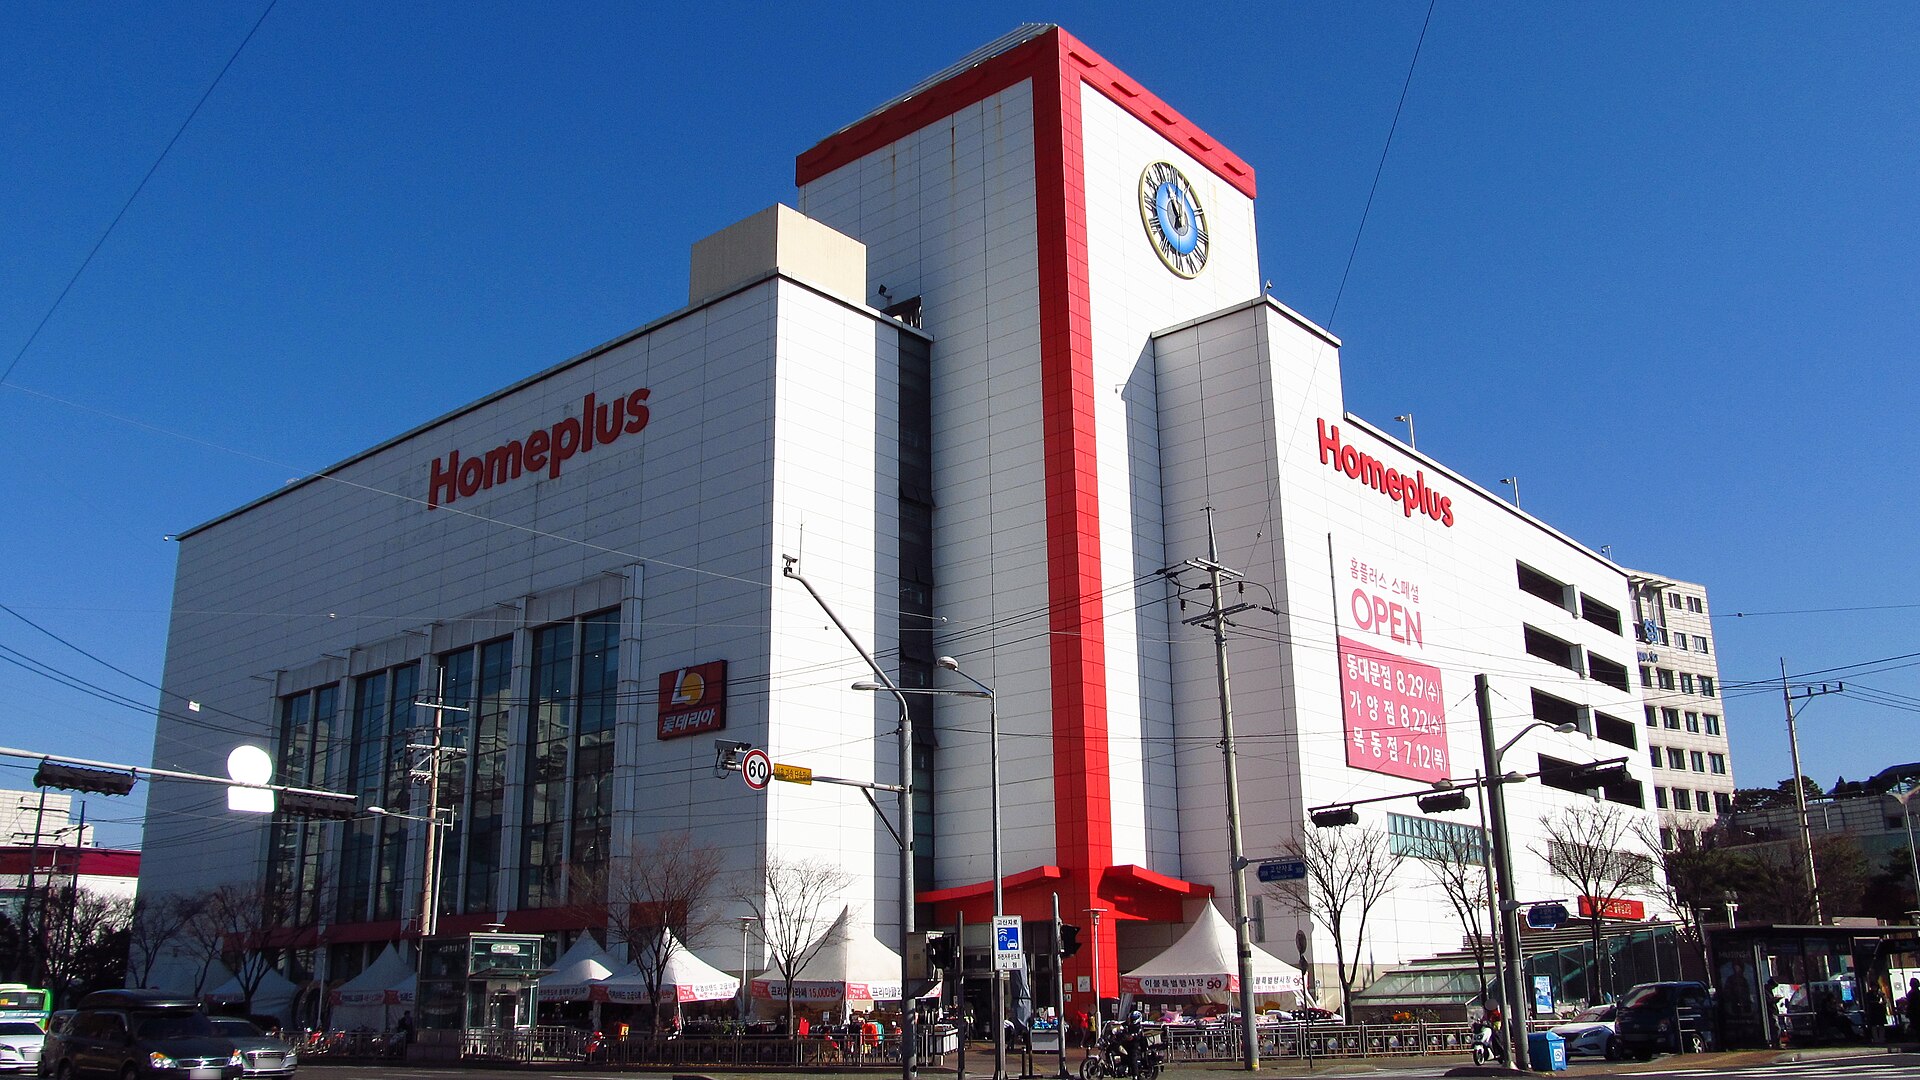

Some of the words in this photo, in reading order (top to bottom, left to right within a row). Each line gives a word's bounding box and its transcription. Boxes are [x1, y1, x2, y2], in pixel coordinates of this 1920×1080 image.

[428, 388, 651, 511] Homeplus
[1317, 417, 1454, 527] Homeplus
[1350, 557, 1387, 589] 홈플러스
[1392, 578, 1419, 604] 스페셜
[1351, 588, 1423, 650] OPEN
[1347, 653, 1392, 691] 동대문점
[1396, 670, 1440, 704] 8.29(수)
[662, 707, 716, 734] 롯데리아
[1400, 704, 1442, 737] 8.22(수)
[748, 760, 766, 779] 60
[1403, 740, 1446, 771] 7.12(목)
